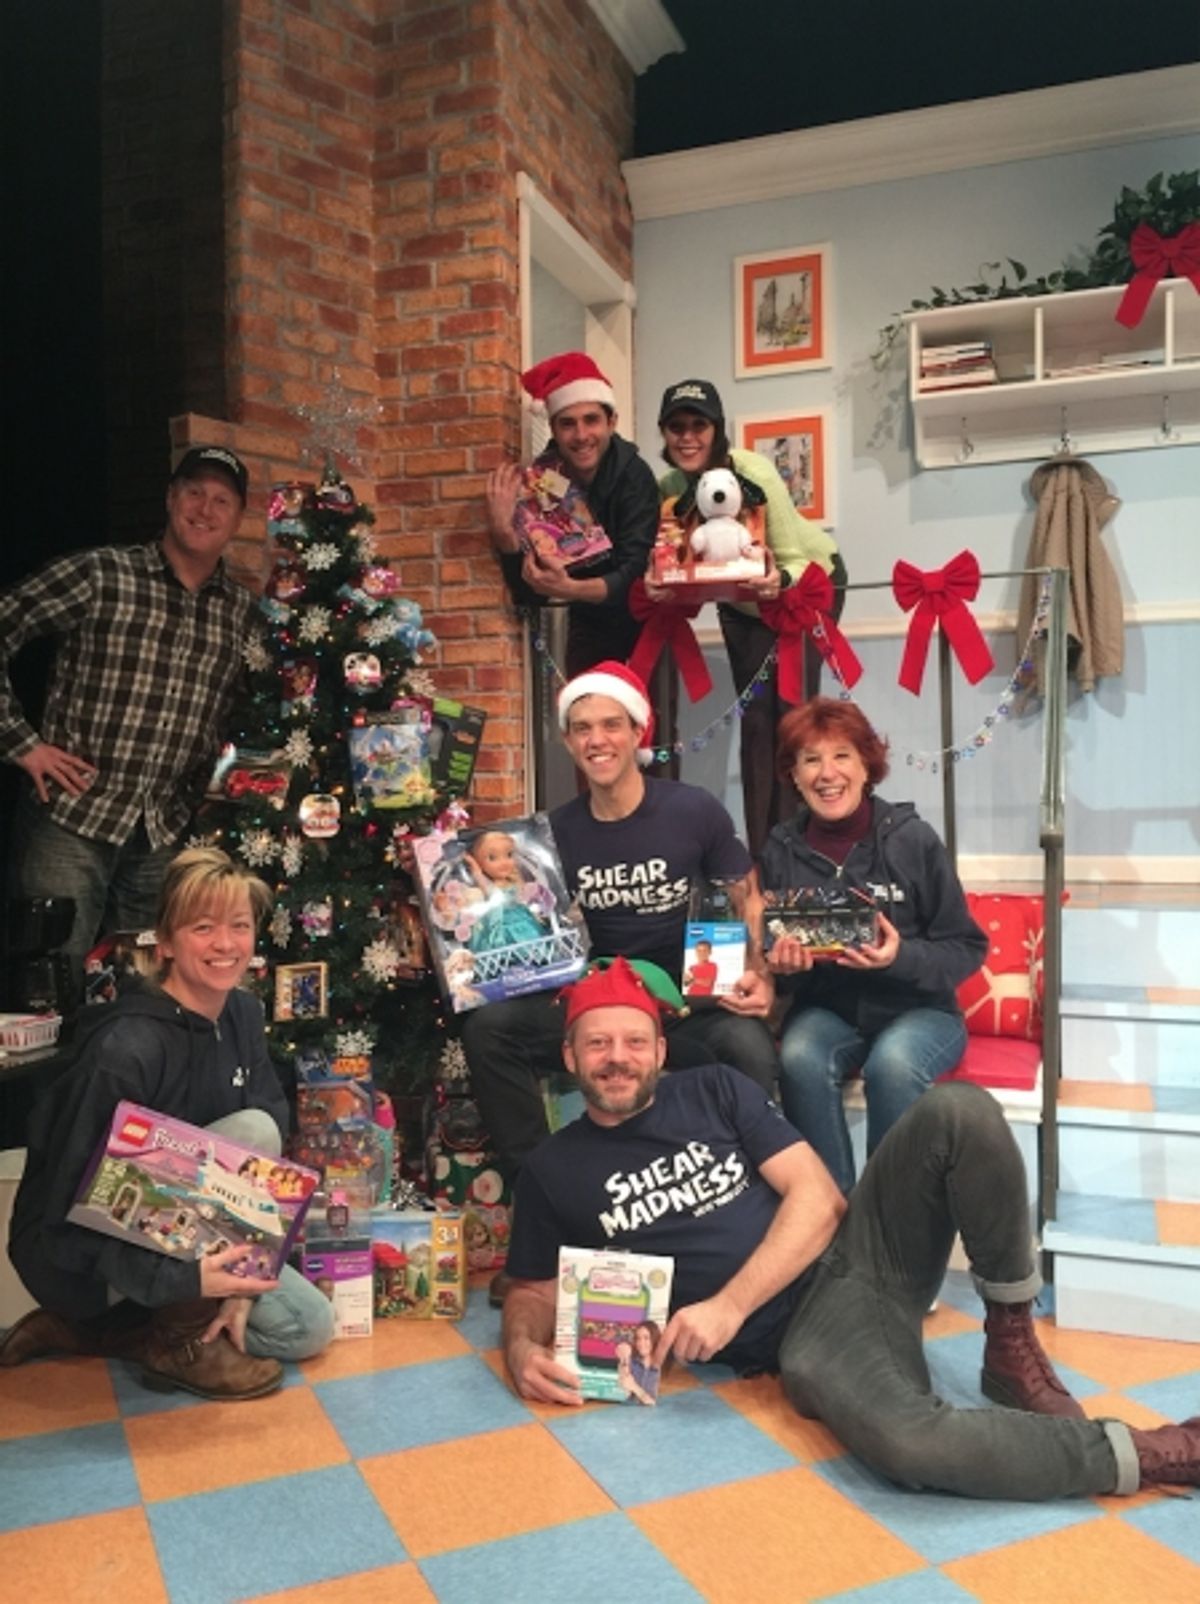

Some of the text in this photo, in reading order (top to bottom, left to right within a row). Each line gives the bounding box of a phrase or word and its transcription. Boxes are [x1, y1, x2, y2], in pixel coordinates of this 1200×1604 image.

[577, 858, 668, 889] SHEAR
[599, 1152, 745, 1239] MADNESS
[604, 1141, 716, 1206] SHEAR
